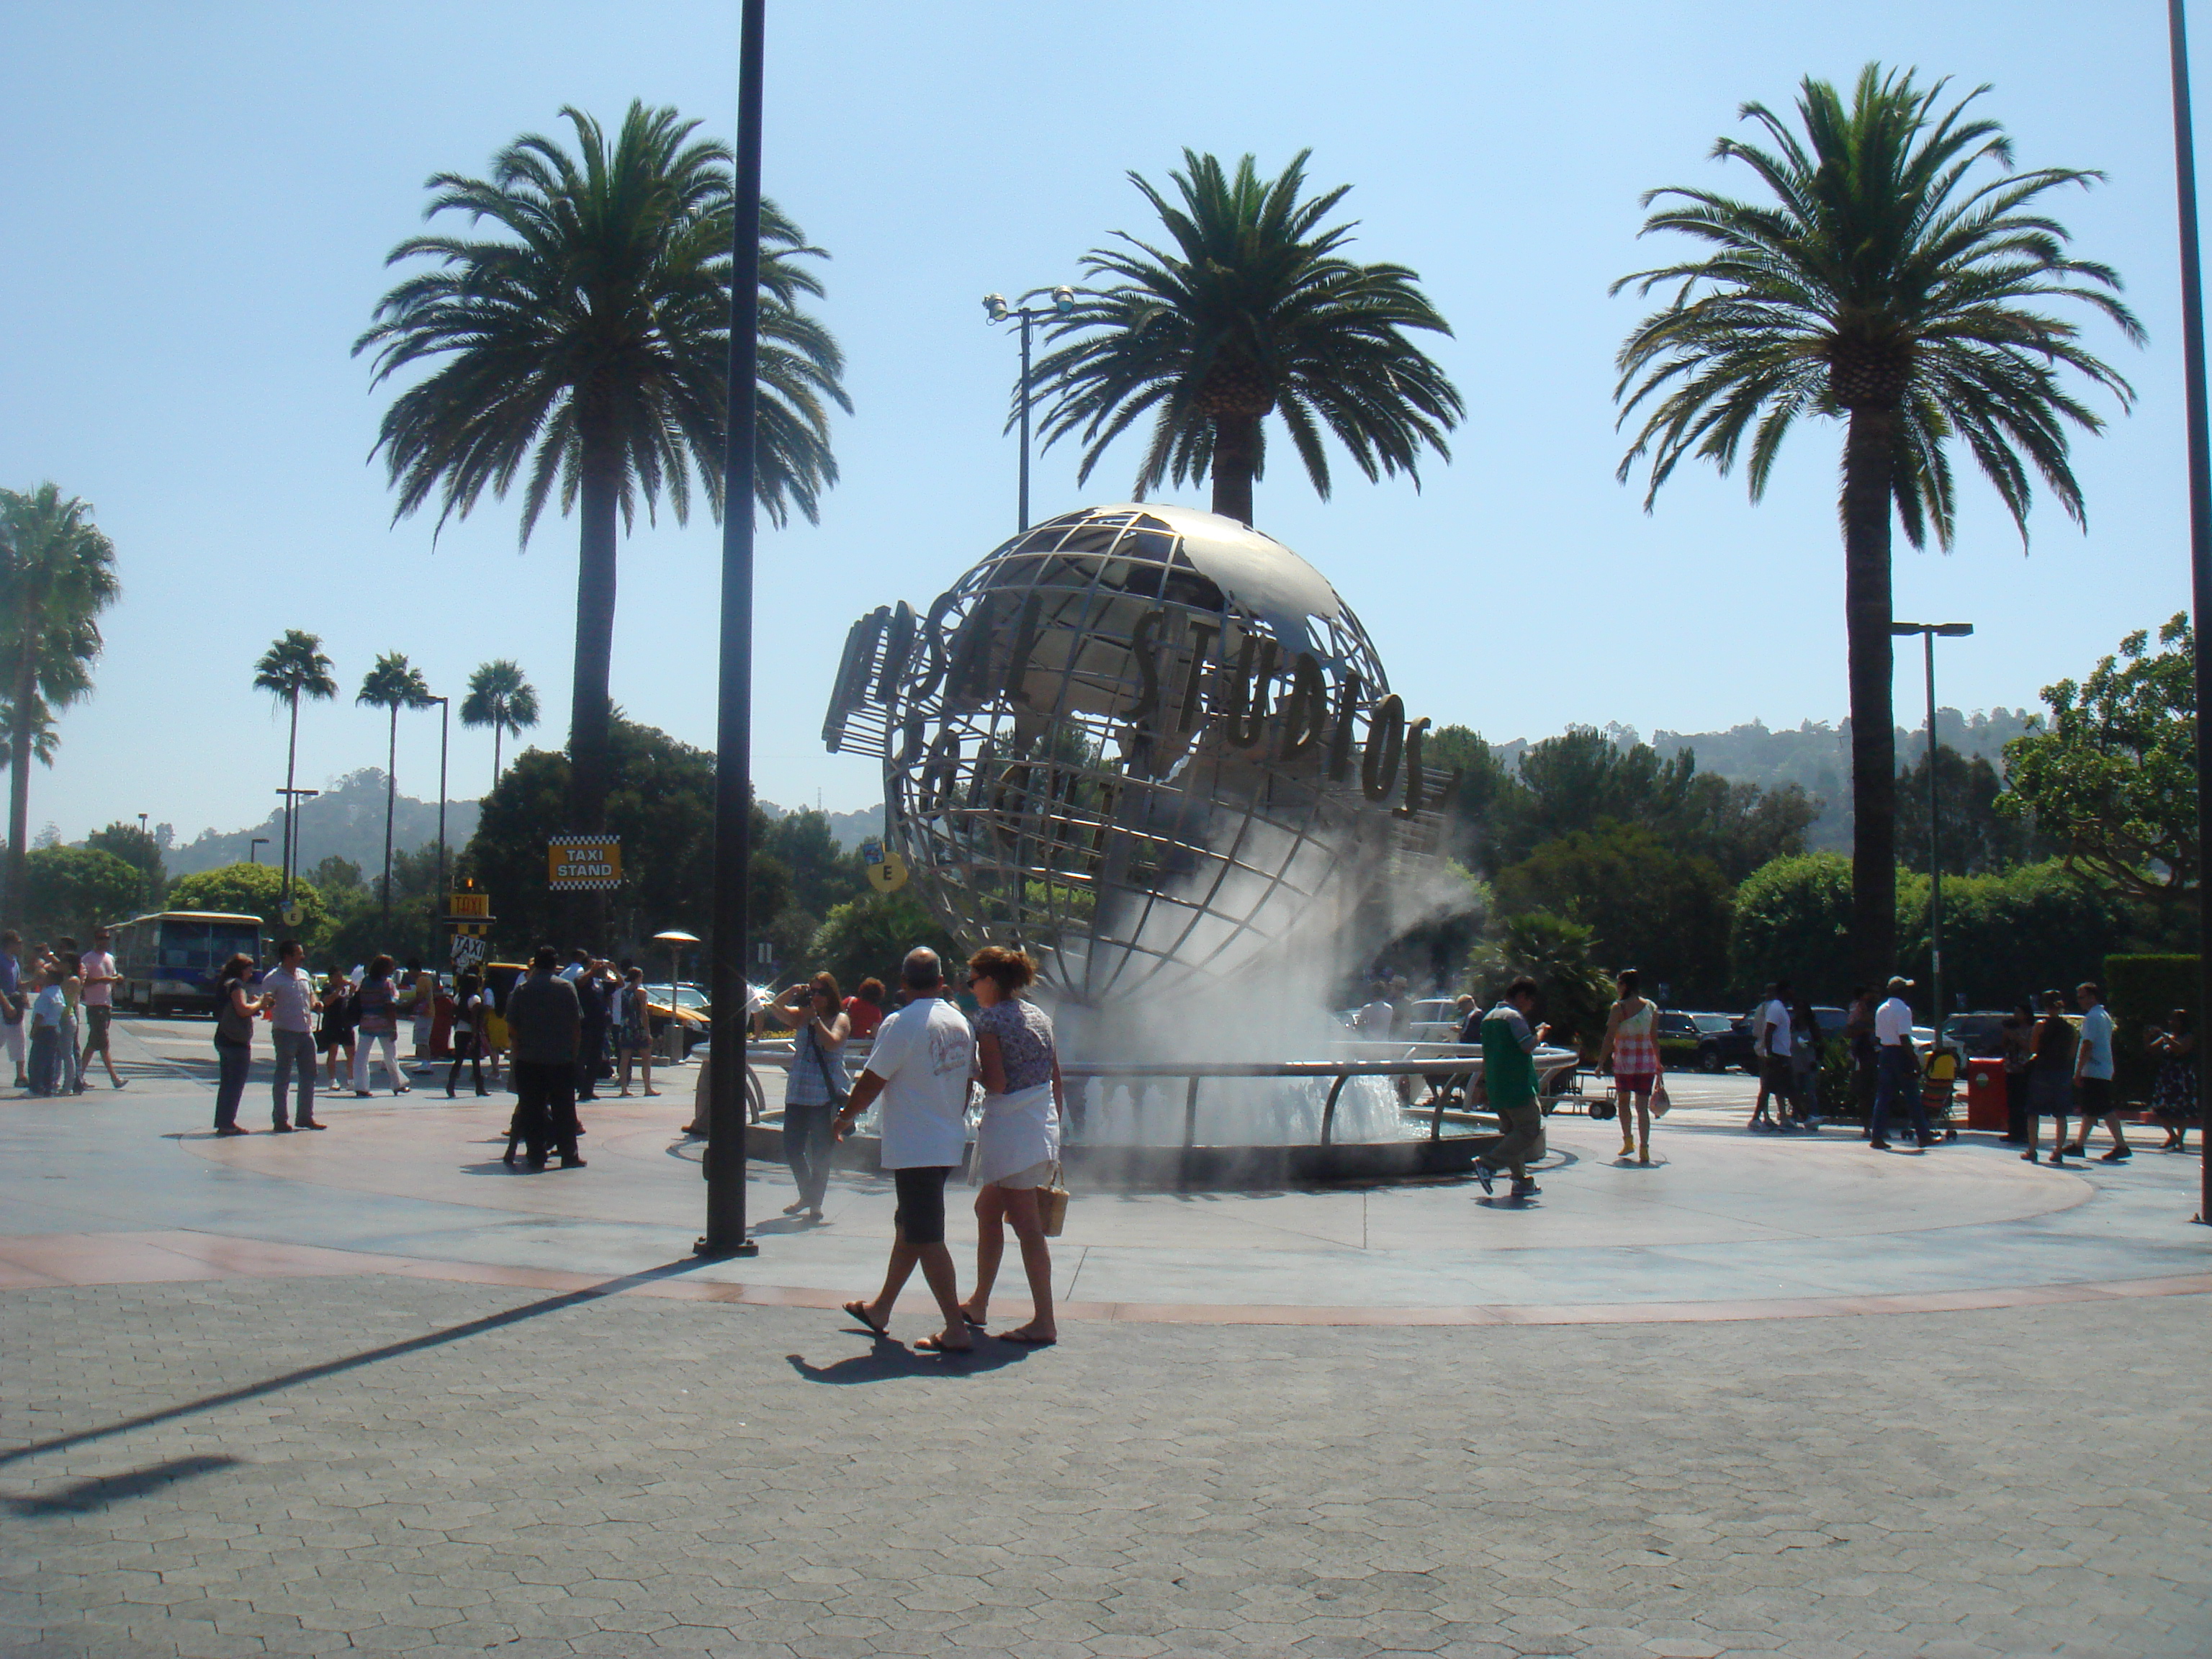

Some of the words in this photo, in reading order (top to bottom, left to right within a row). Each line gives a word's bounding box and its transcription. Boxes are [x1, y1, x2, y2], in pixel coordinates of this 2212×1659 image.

[1119, 611, 1432, 820] STUDIOS
[566, 850, 603, 862] TAXI
[557, 864, 612, 876] STAND
[884, 866, 892, 881] E
[455, 896, 482, 915] TAXI
[457, 936, 485, 957] TAXI
